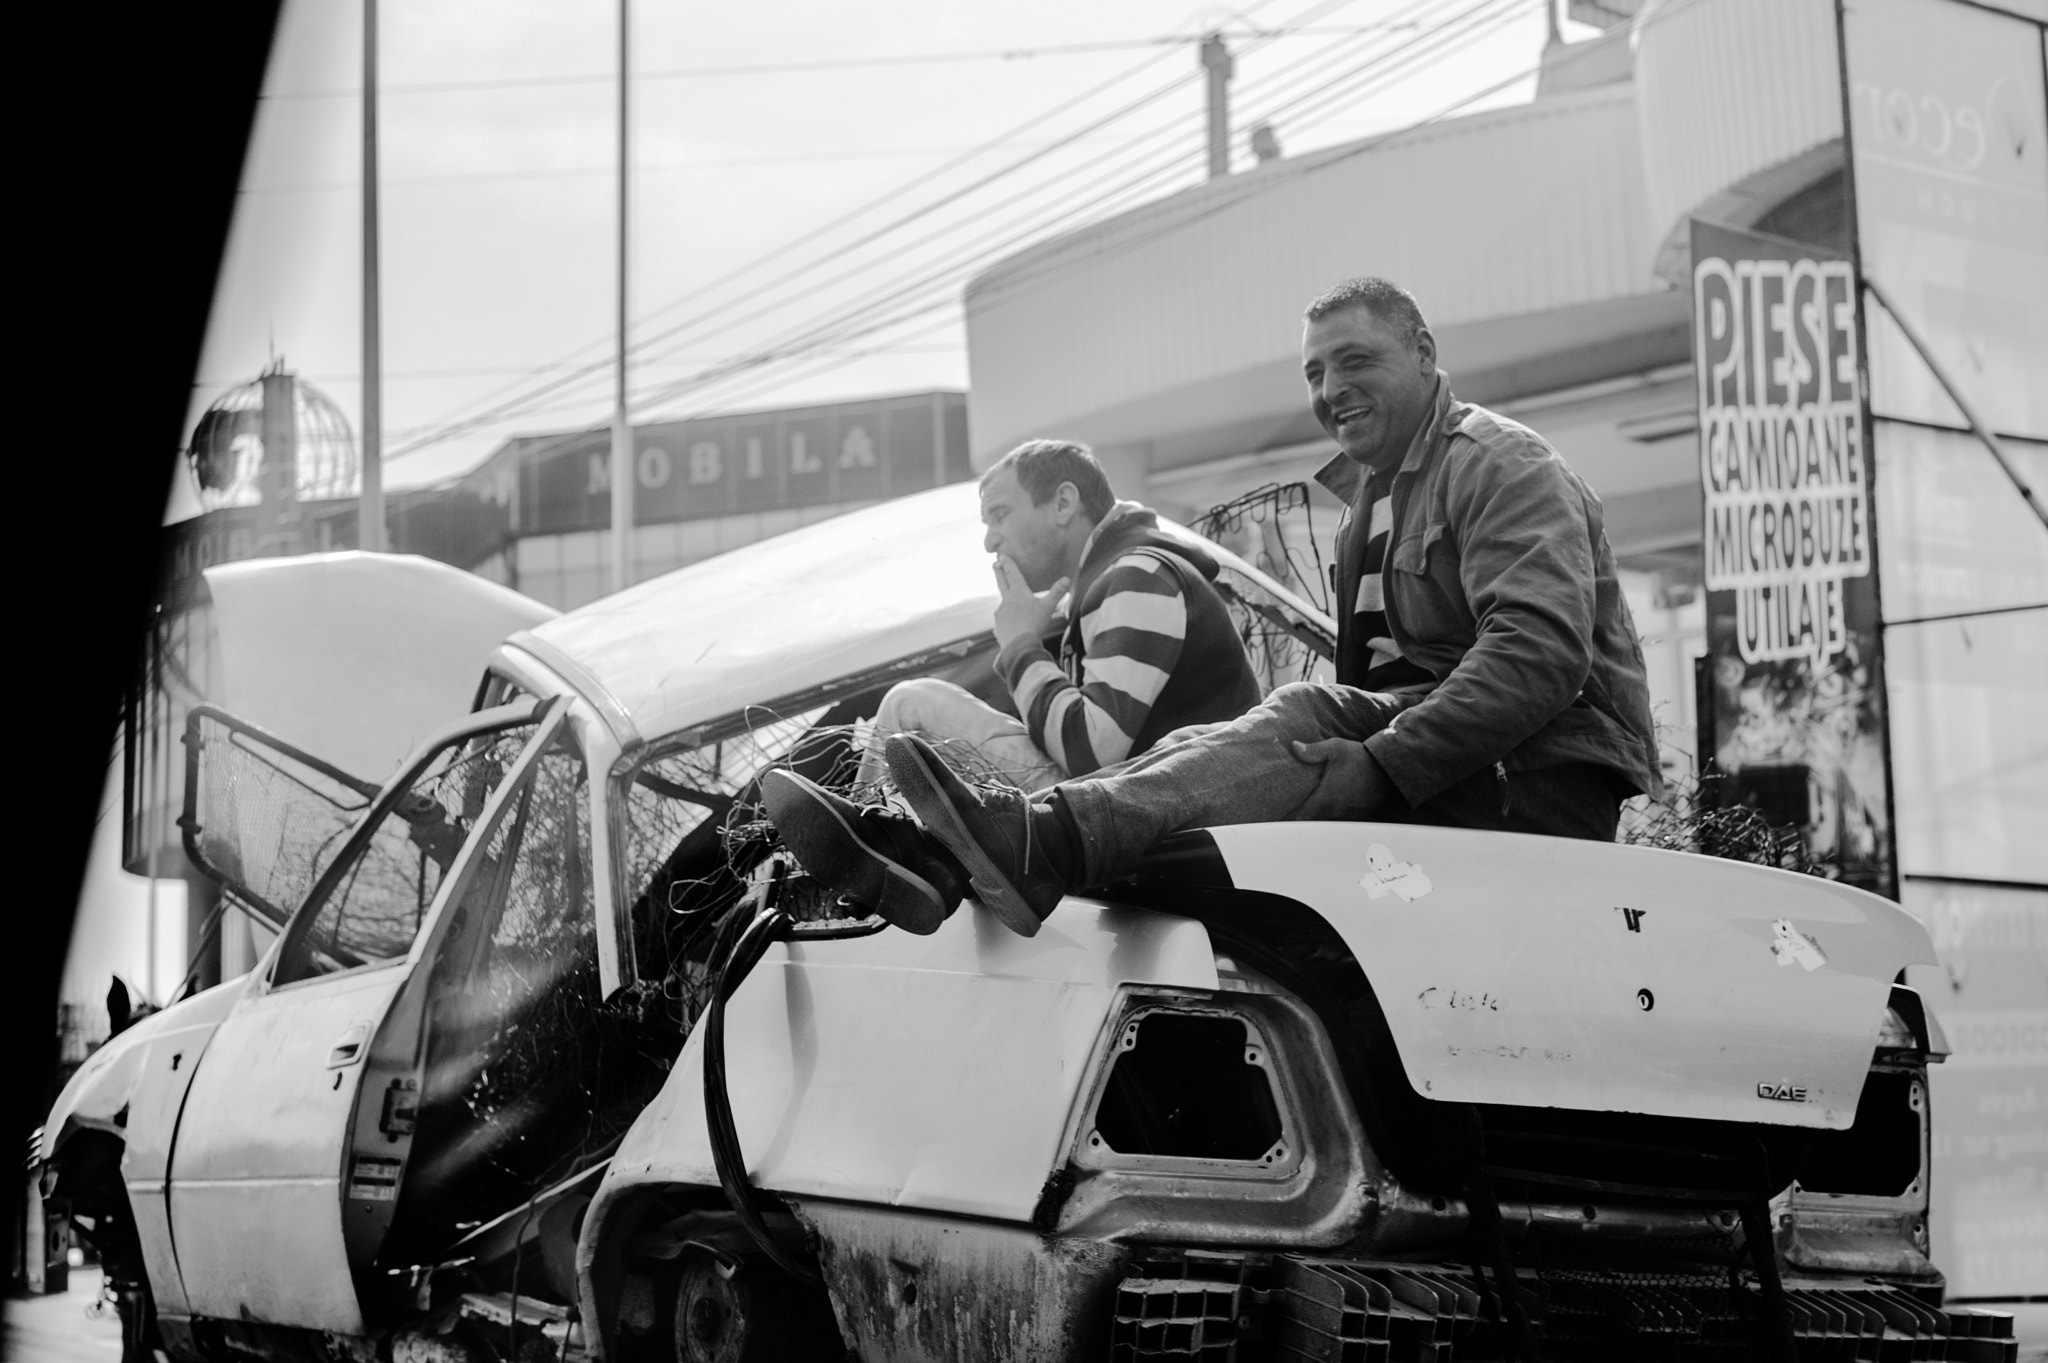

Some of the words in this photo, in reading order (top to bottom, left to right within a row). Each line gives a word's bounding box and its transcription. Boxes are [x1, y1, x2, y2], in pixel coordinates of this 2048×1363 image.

[1695, 257, 1856, 406] PIESE
[586, 425, 878, 496] MOBILA
[1702, 403, 1862, 496] CAMIOANE
[1705, 496, 1870, 590] MICROBUZE
[1736, 578, 1846, 672] UTILAJE
[1757, 1082, 1807, 1103] DAE
